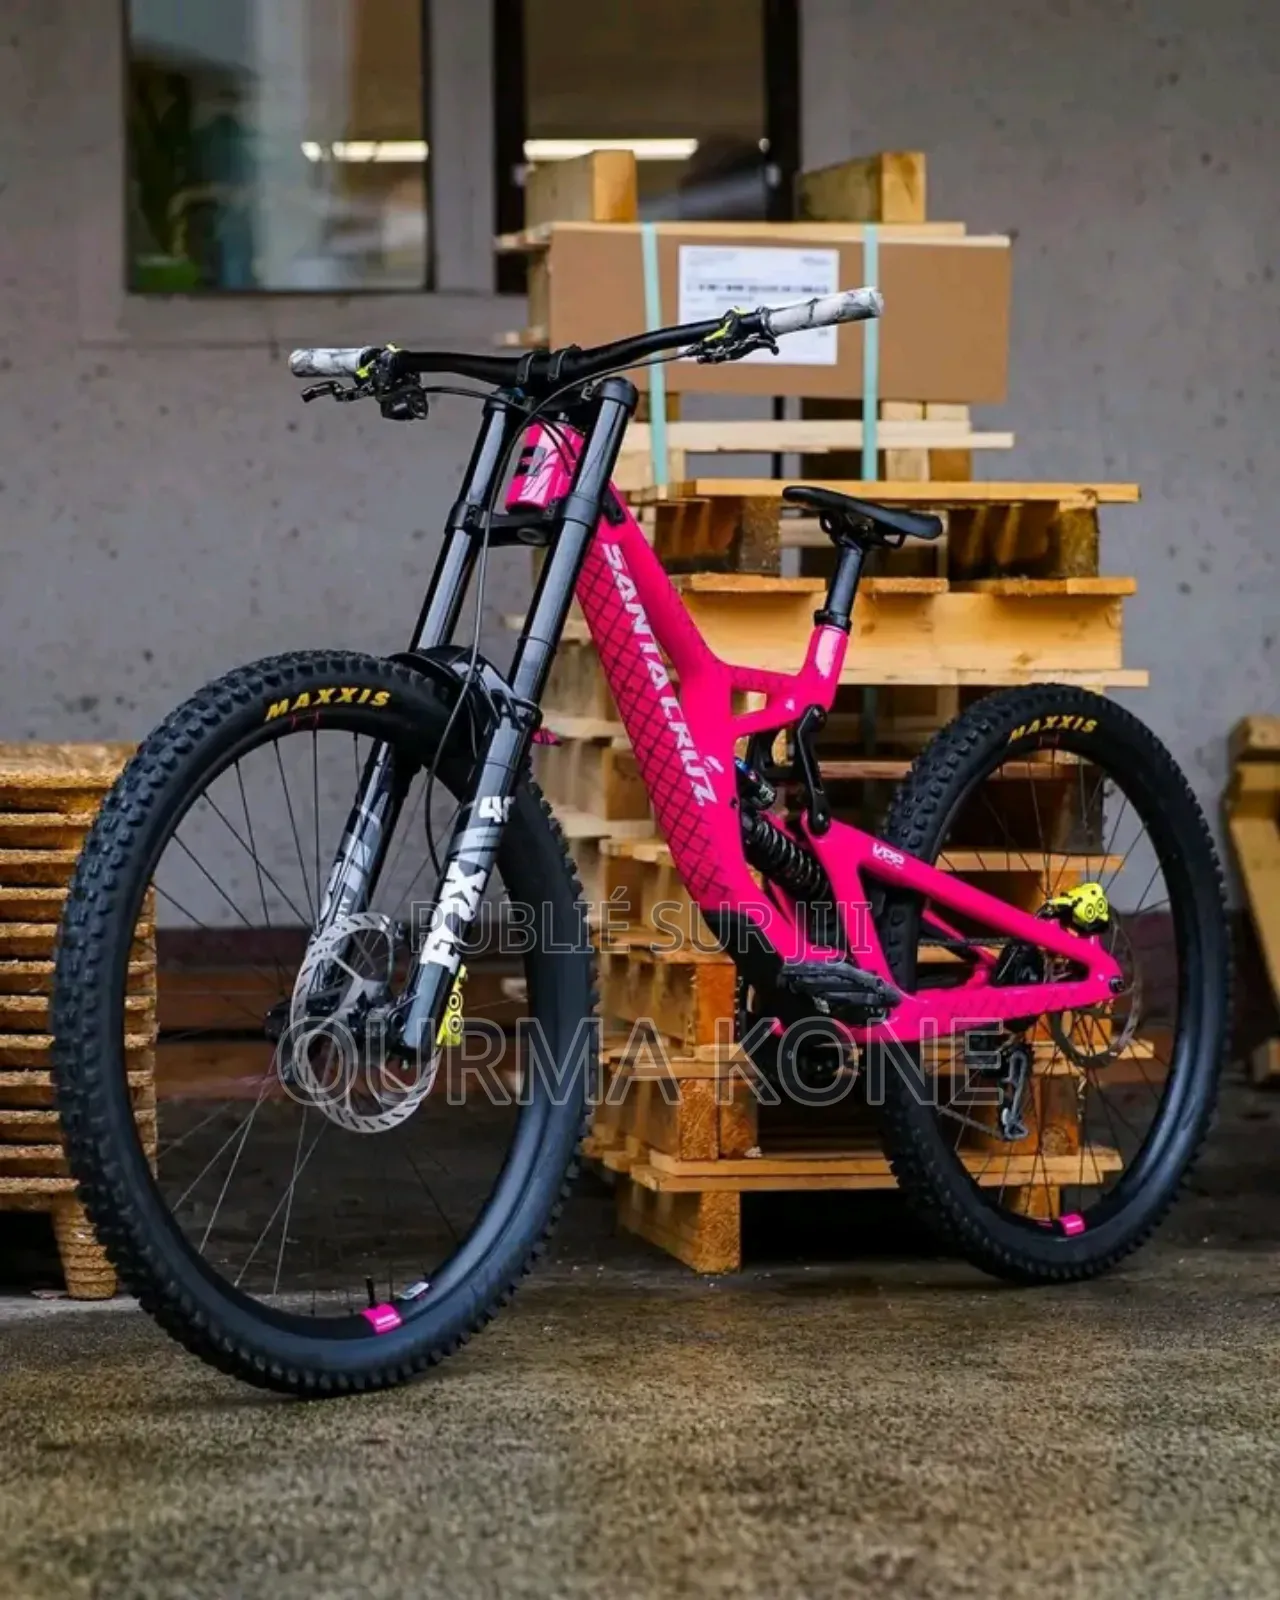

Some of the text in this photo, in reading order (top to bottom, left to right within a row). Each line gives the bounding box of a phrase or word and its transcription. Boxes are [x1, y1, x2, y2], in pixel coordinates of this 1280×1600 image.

[602, 542, 671, 692] SANTA
[264, 687, 392, 722] MAXXIS
[1007, 715, 1098, 746] MAXXIS
